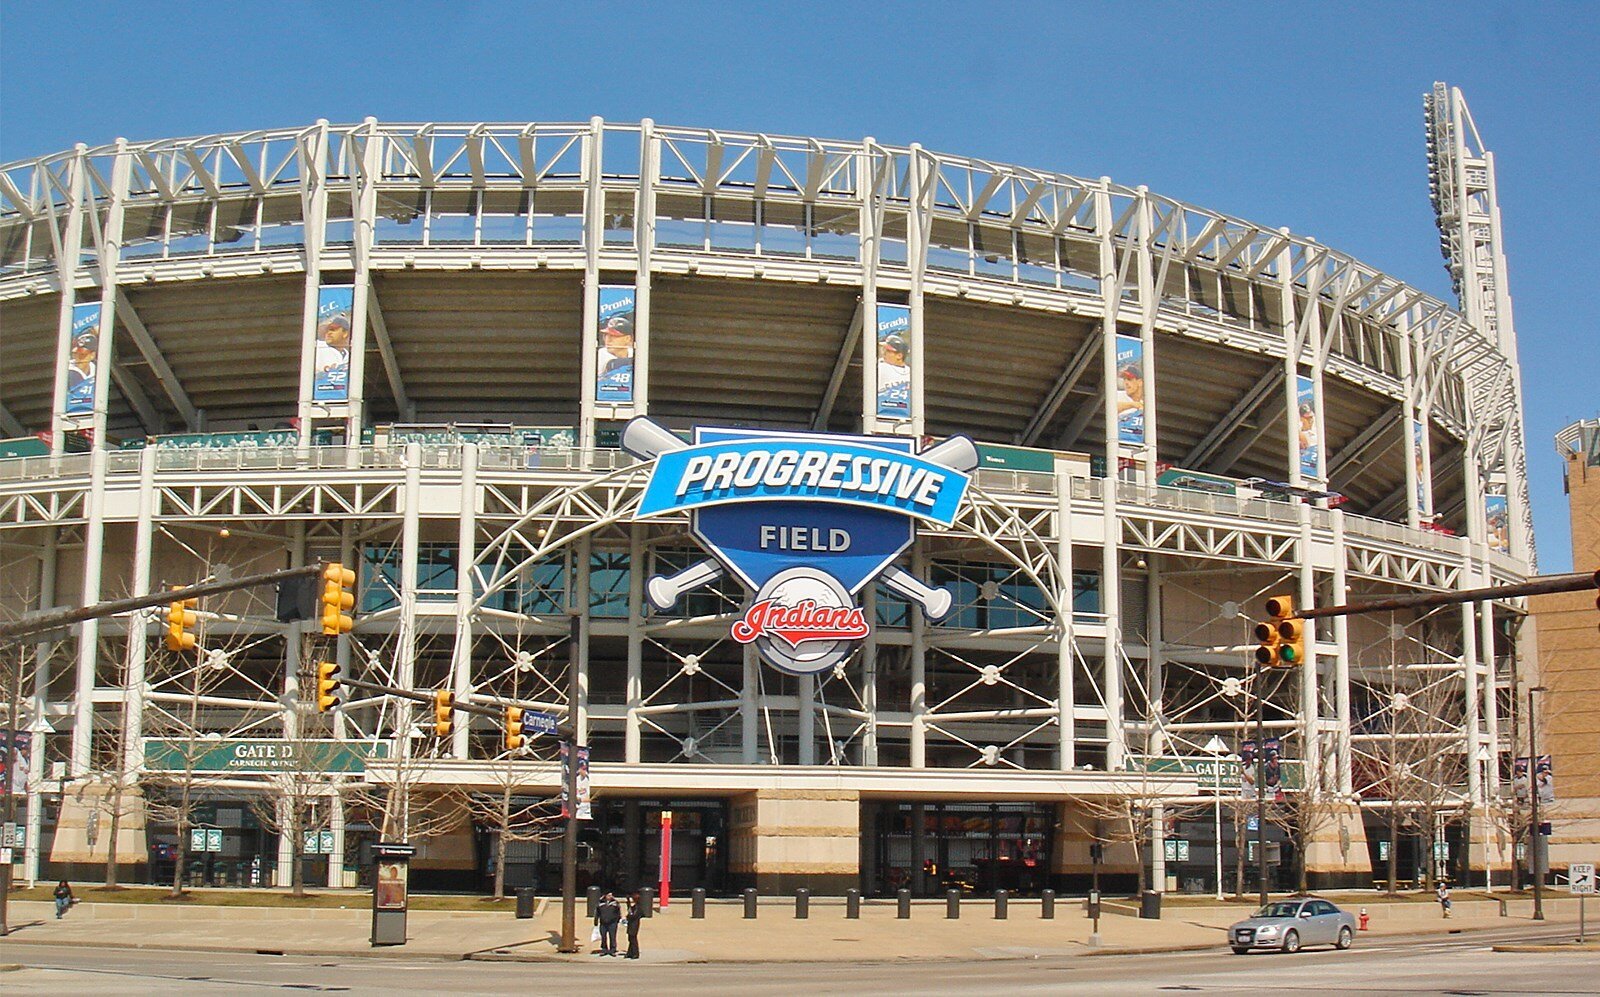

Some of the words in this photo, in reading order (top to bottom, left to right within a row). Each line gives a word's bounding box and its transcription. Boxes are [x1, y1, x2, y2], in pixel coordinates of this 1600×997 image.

[320, 301, 339, 314] C.C.
[600, 297, 633, 313] Pronk
[879, 317, 908, 331] Grady
[327, 371, 347, 382] 52
[610, 373, 631, 384] 48
[79, 385, 93, 395] 41
[890, 389, 909, 400] 24
[675, 449, 946, 507] PROGRESSIVE
[760, 525, 851, 552] FIELD
[730, 597, 870, 650] Indians
[523, 712, 556, 730] Carnegie
[235, 744, 276, 759] GATE
[281, 744, 294, 759] D
[1195, 763, 1228, 776] GATE
[1229, 764, 1240, 776] D
[1573, 866, 1592, 874] KEEP
[1571, 885, 1593, 893] RIGHT
